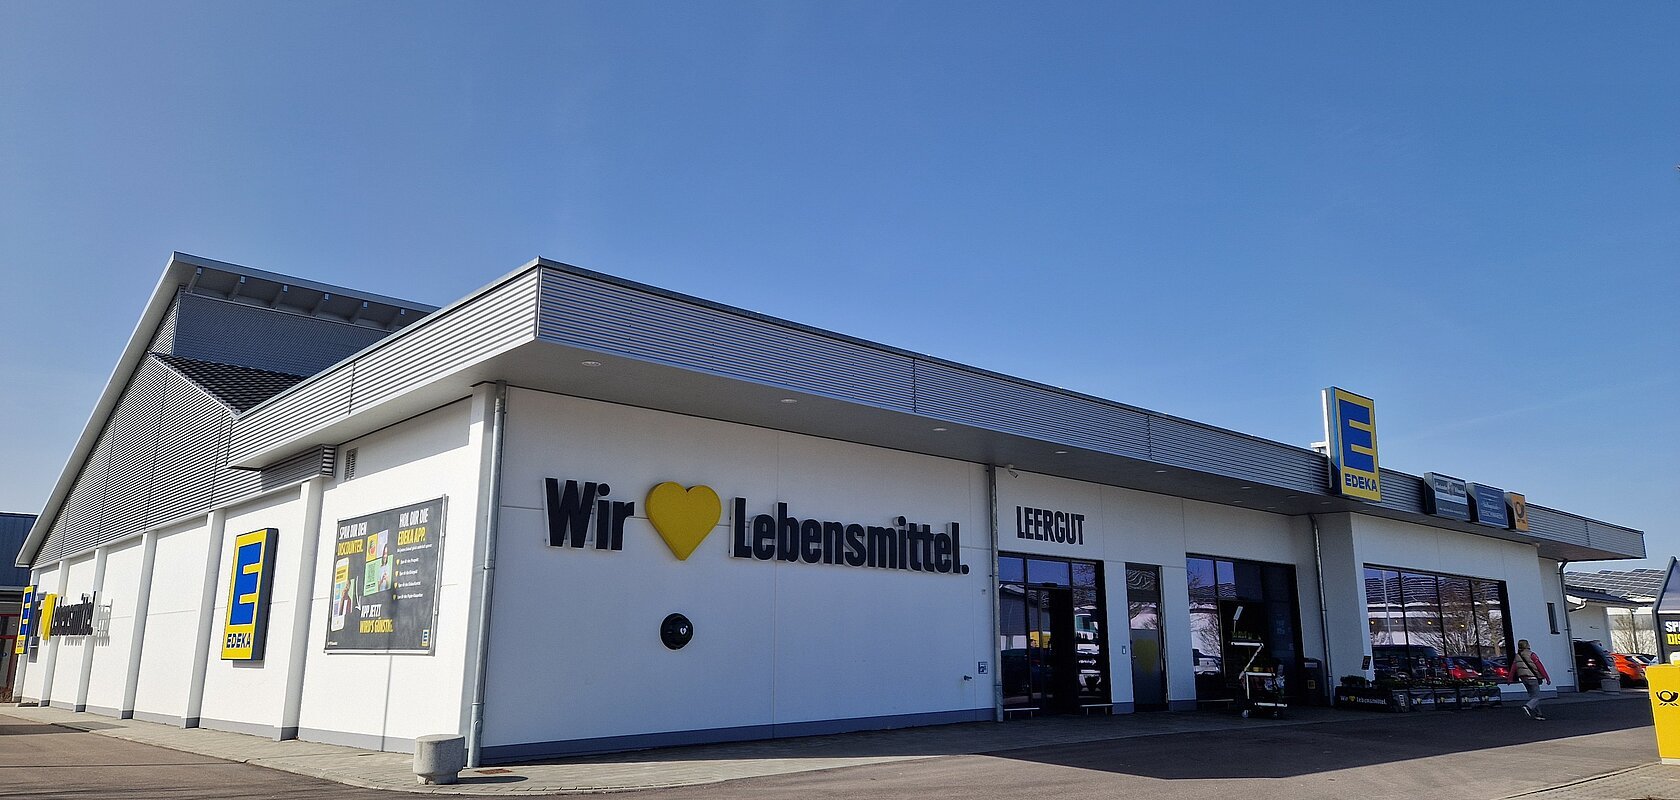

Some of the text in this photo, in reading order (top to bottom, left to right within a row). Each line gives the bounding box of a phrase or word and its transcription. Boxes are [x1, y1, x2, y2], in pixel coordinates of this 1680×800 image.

[1345, 473, 1378, 492] EDEKA
[544, 477, 970, 576] Wir Lebensmittel.
[1016, 505, 1085, 545] LEERGUT
[397, 529, 414, 545] EDEKA
[226, 632, 251, 648] EDEKA
